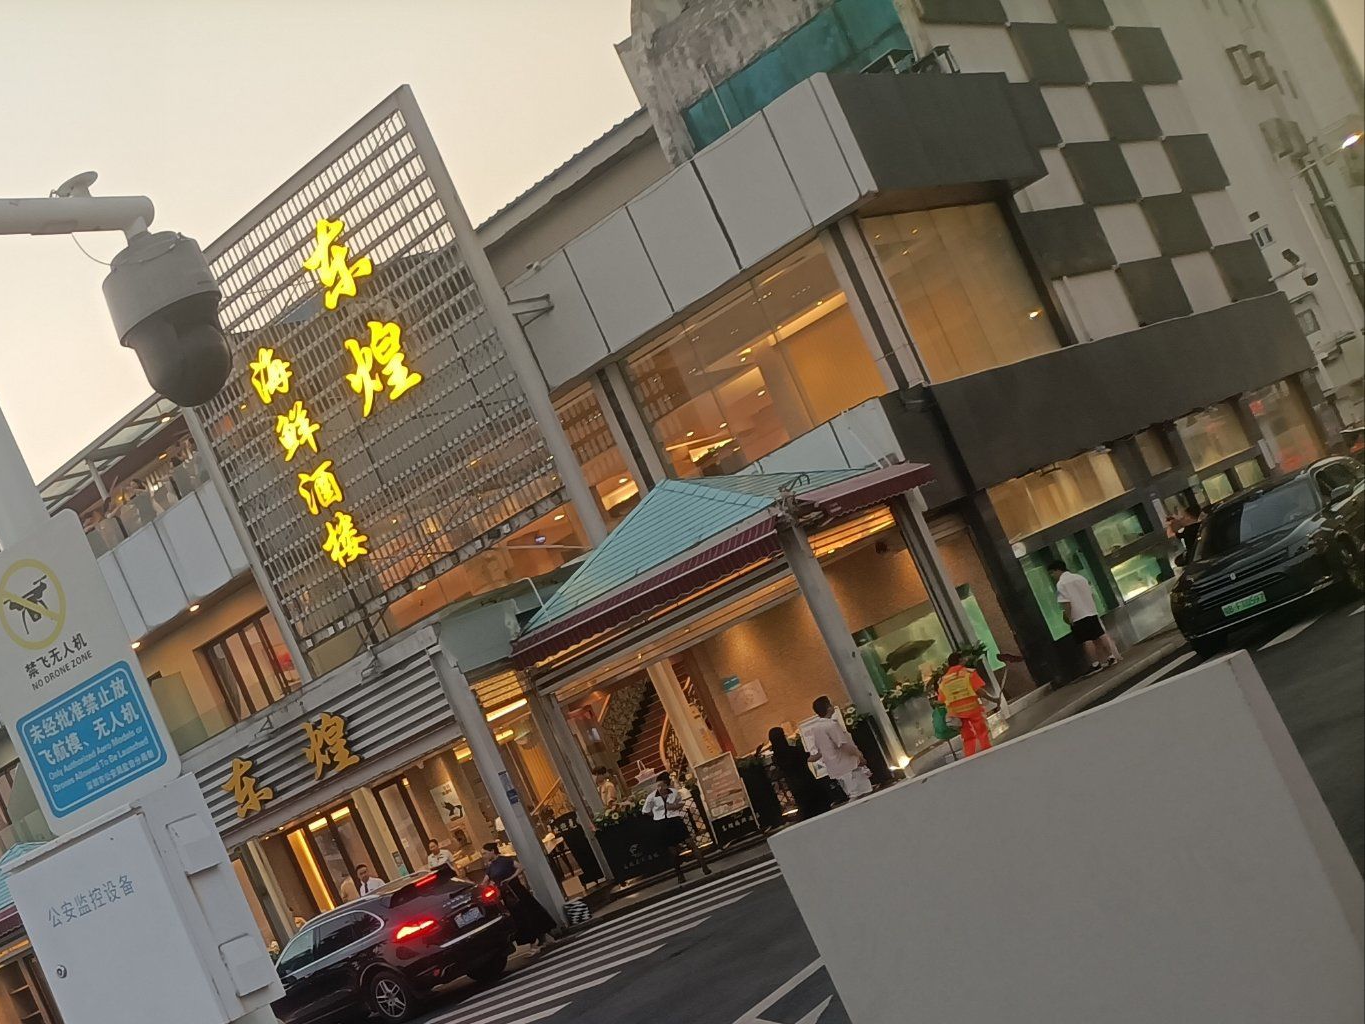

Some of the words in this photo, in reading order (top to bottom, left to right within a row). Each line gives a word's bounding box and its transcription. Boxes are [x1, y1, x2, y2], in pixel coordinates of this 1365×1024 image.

[25, 633, 87, 679] 禁飞无人机
[32, 679, 44, 690] NO
[44, 663, 71, 684] DRONE
[71, 650, 92, 668] ZONE
[29, 677, 128, 744] 未经批准禁止放
[49, 769, 64, 780] Only
[100, 758, 108, 768] To
[108, 753, 117, 763] Be
[48, 875, 134, 928] 公安监控设备
